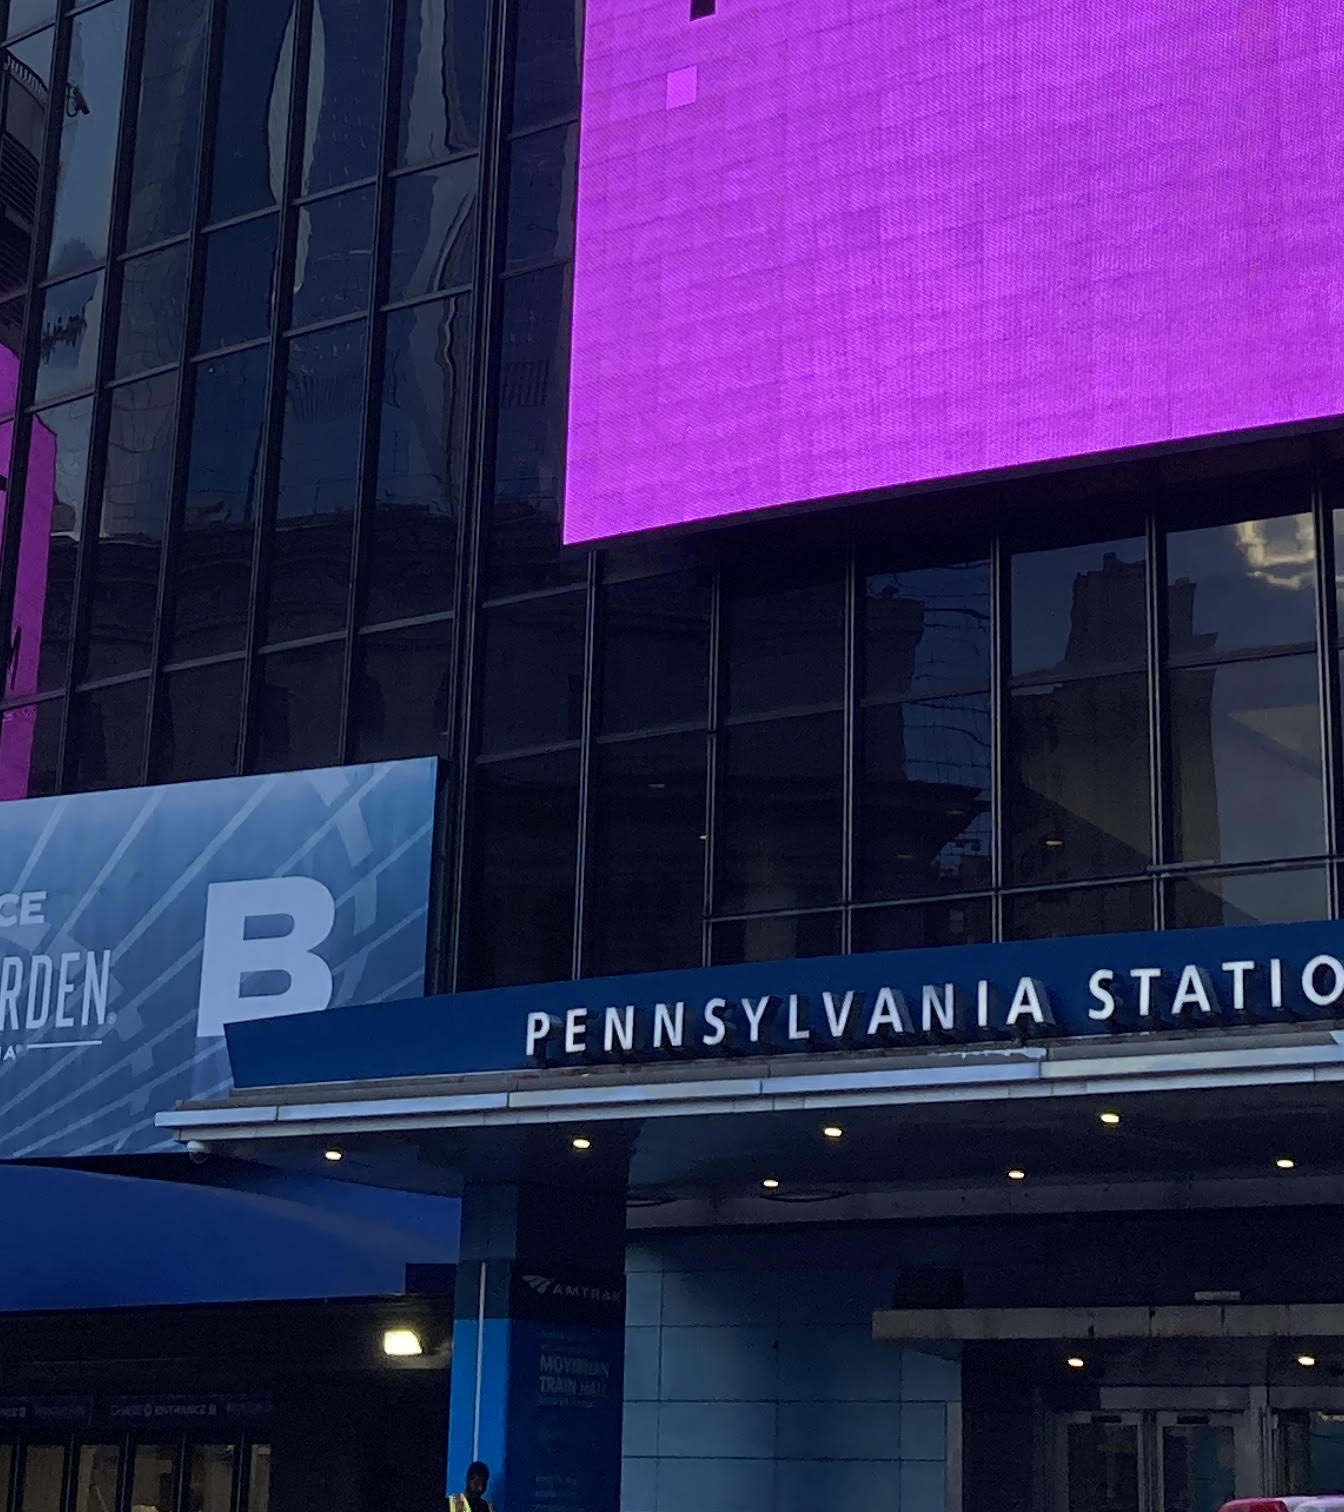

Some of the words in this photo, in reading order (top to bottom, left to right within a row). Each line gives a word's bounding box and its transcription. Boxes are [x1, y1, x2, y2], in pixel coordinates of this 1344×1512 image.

[197, 876, 335, 1037] B
[525, 976, 1045, 1056] PENNSYLVANIA
[552, 1283, 623, 1302] AMTRAK
